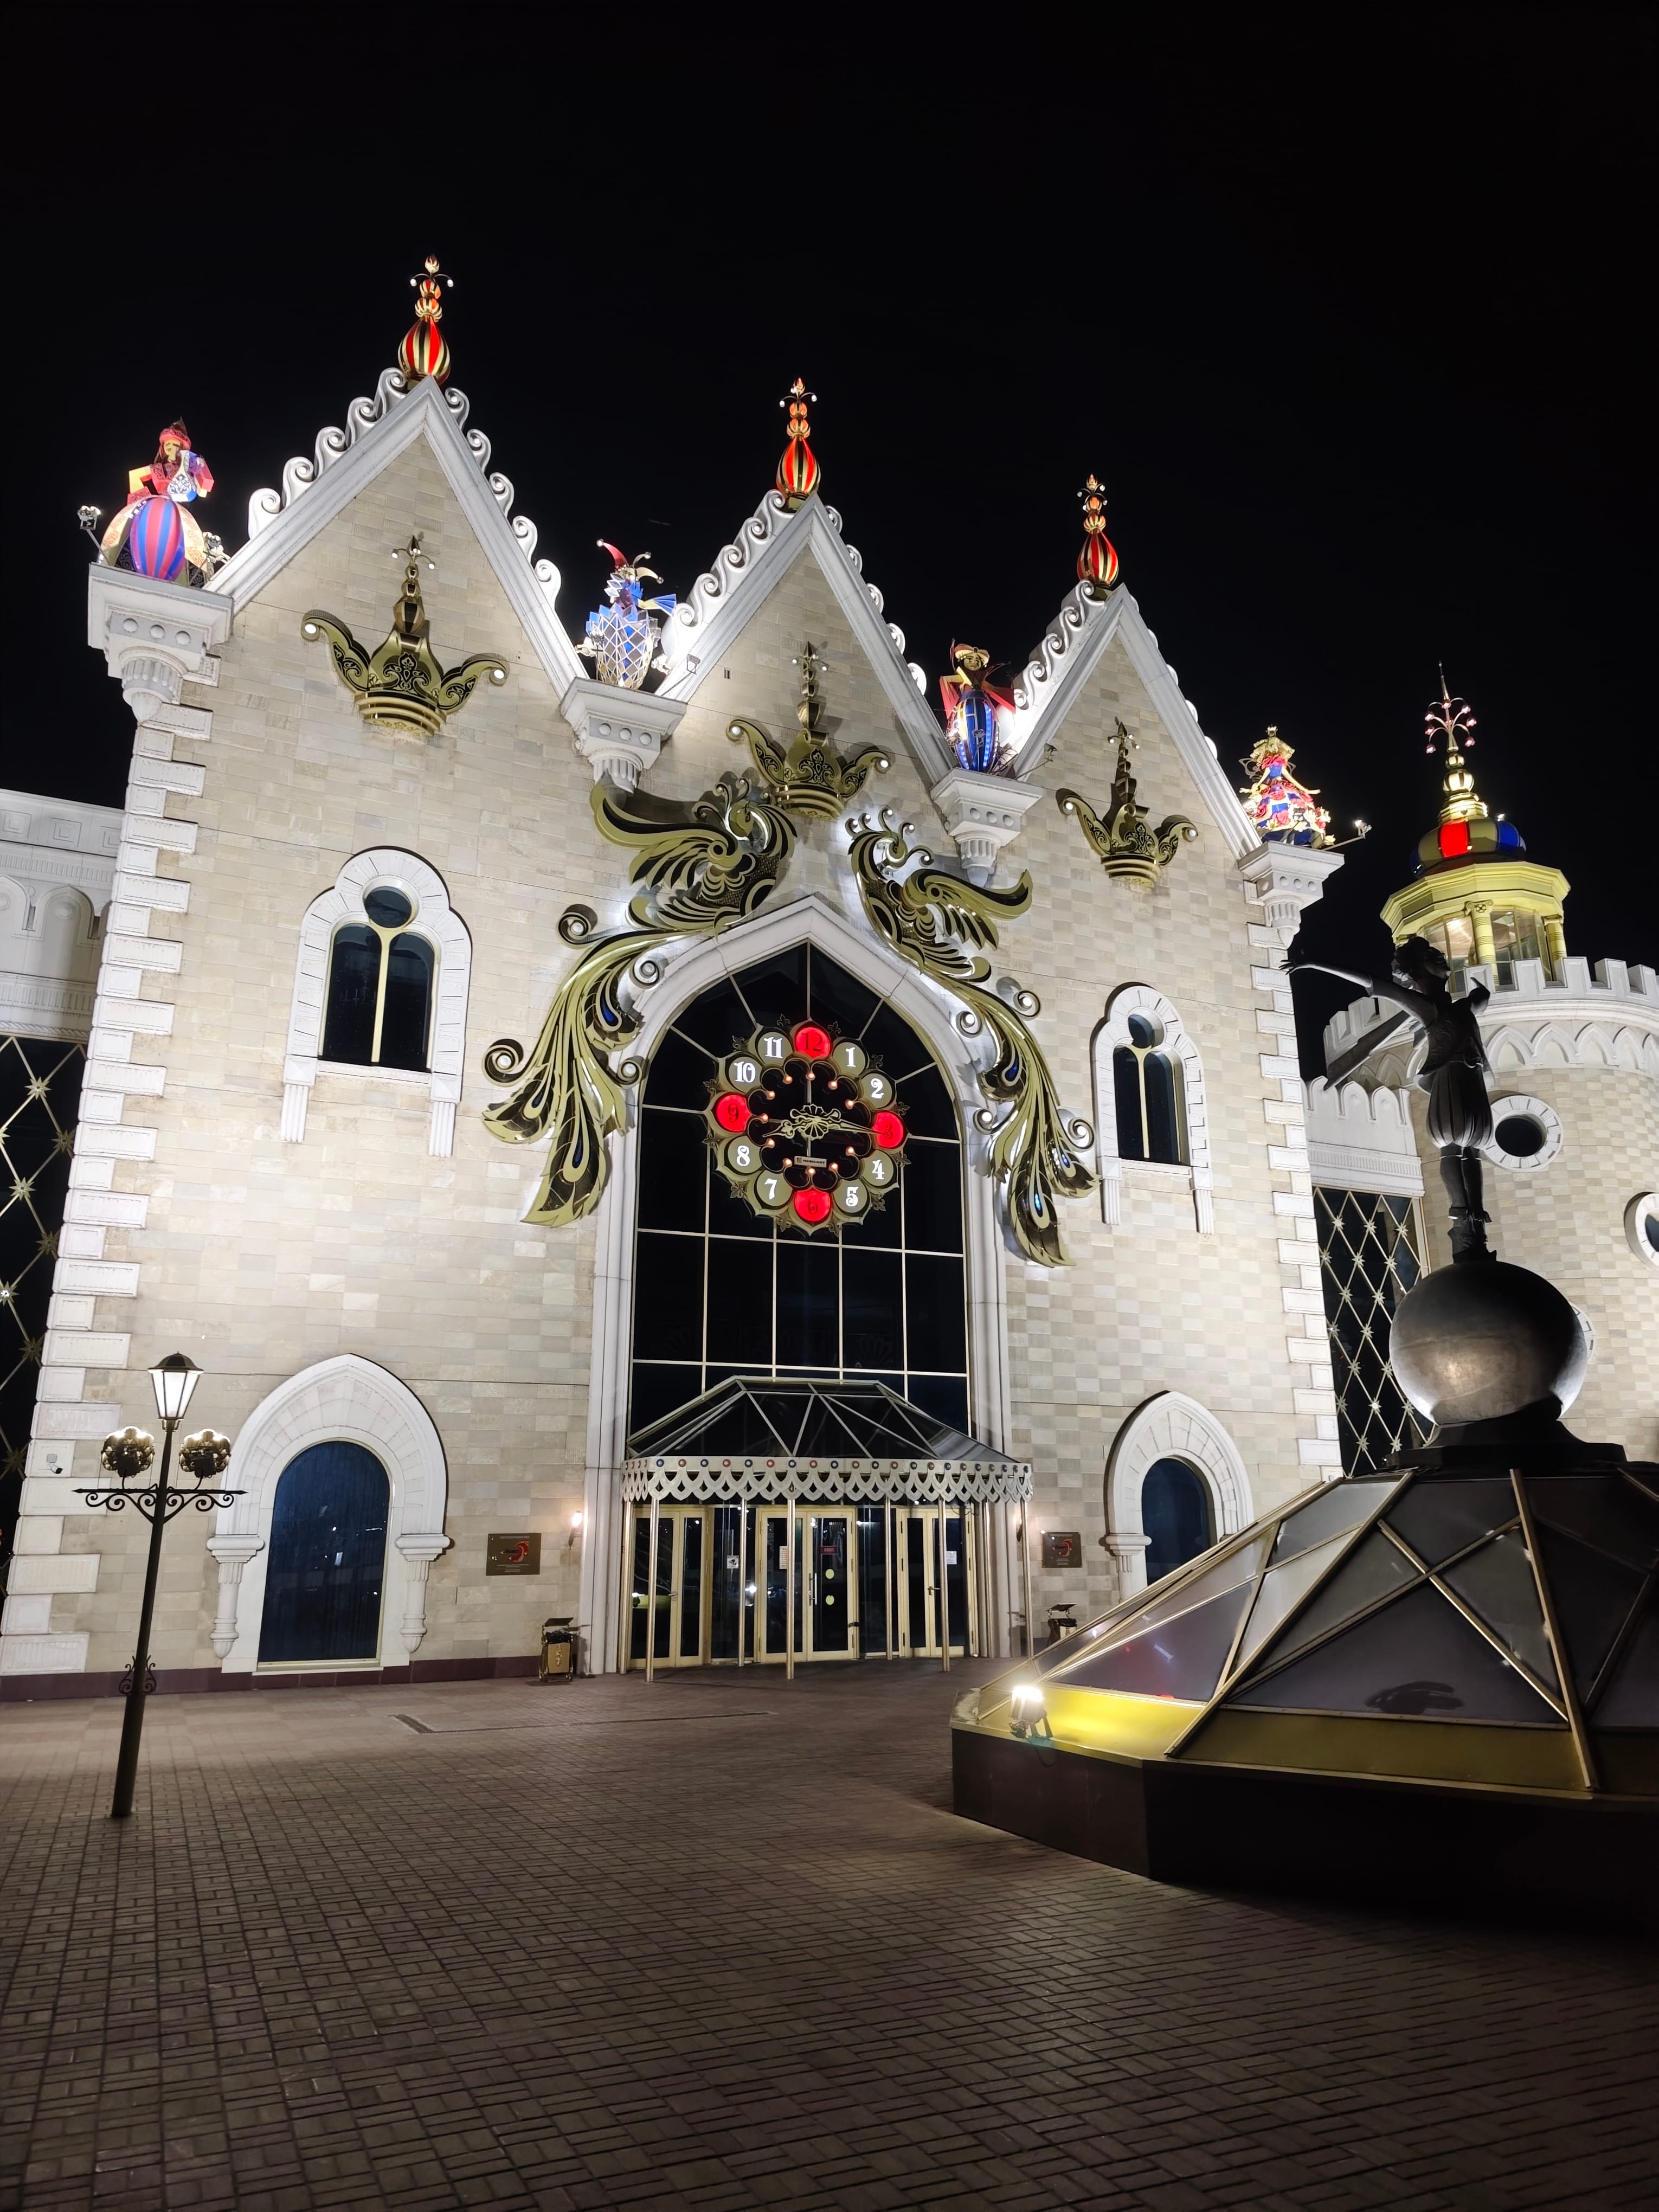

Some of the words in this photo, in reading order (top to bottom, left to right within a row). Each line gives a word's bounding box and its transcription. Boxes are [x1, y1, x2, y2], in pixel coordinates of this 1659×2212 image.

[763, 1037, 783, 1058] 11
[801, 1032, 823, 1052] 12
[845, 1047, 856, 1068] 1
[734, 1061, 756, 1083] 10
[871, 1078, 884, 1099] 2
[728, 1103, 739, 1123] 9
[884, 1121, 893, 1141] 3
[736, 1145, 750, 1166] 8
[872, 1159, 885, 1180] 4
[764, 1178, 777, 1200] 7
[845, 1186, 859, 1207] 5
[807, 1194, 819, 1214] 6
